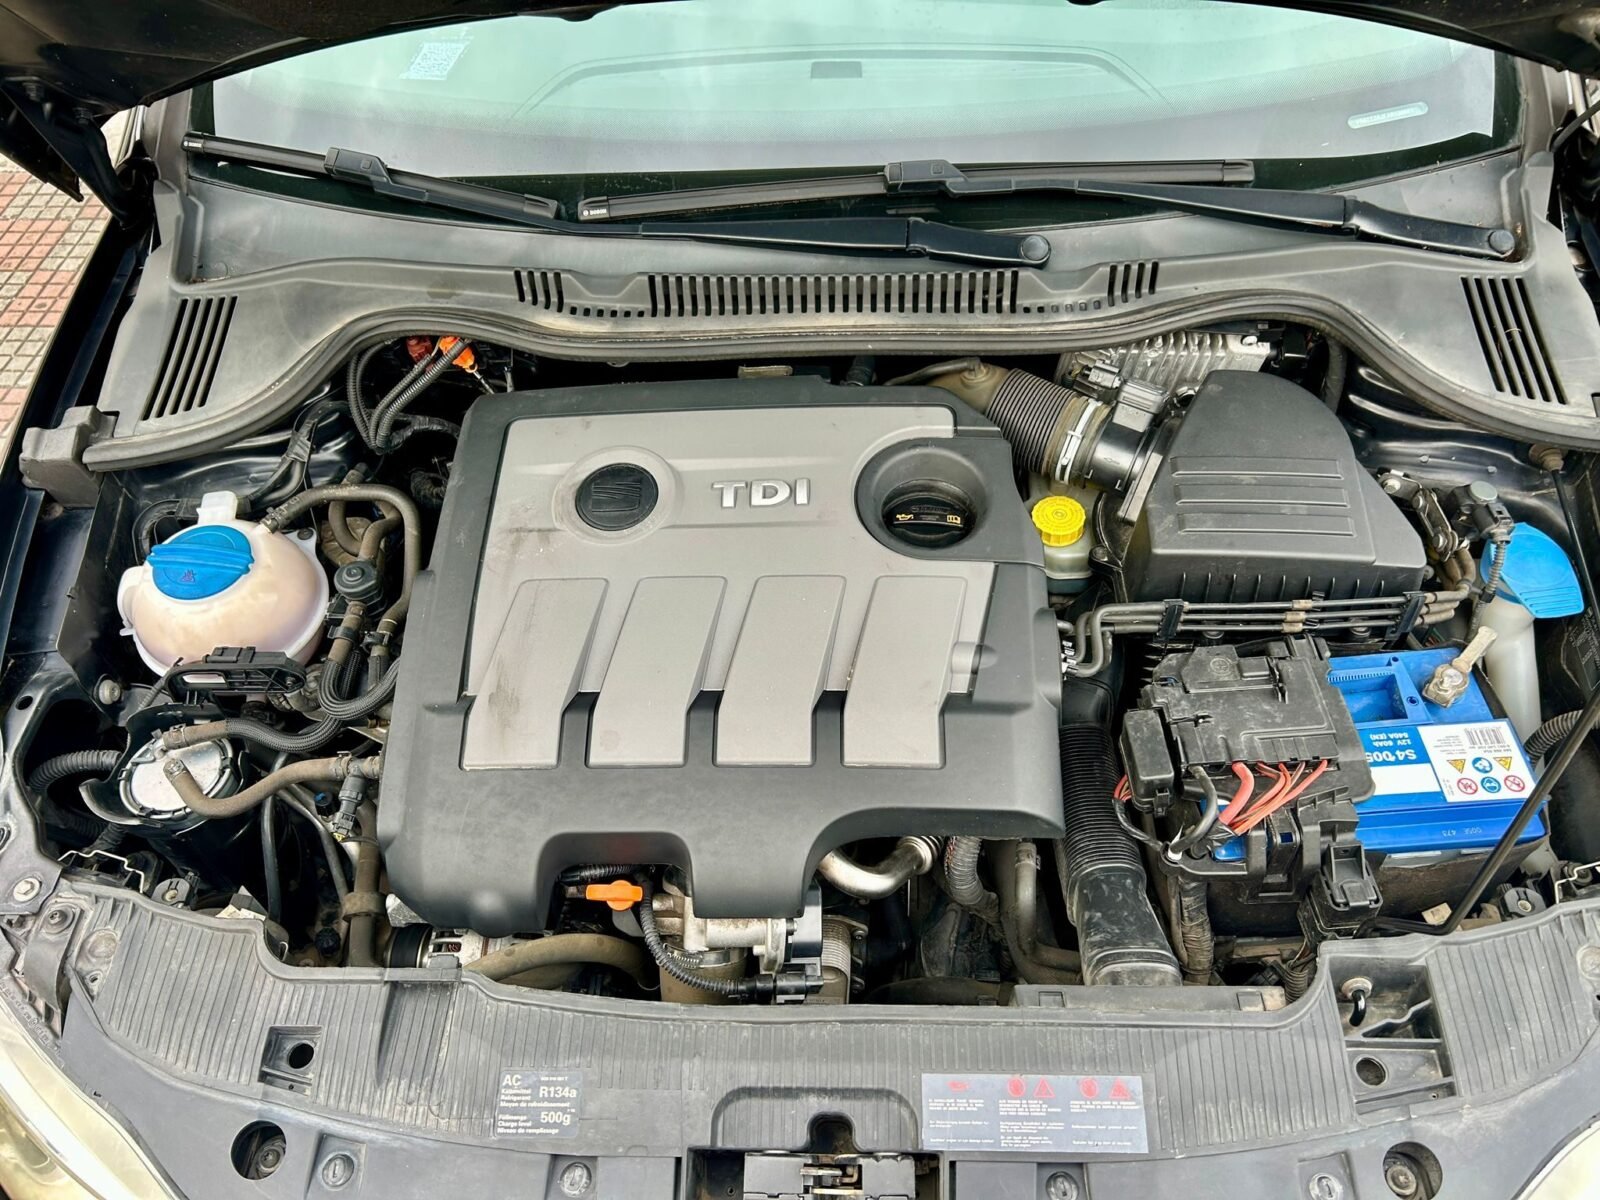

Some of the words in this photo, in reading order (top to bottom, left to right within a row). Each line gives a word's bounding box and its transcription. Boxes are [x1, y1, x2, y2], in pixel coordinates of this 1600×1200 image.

[712, 478, 810, 508] TDI
[502, 1074, 522, 1086] AC
[539, 1086, 577, 1098] R134a
[540, 1111, 571, 1126] 500g
